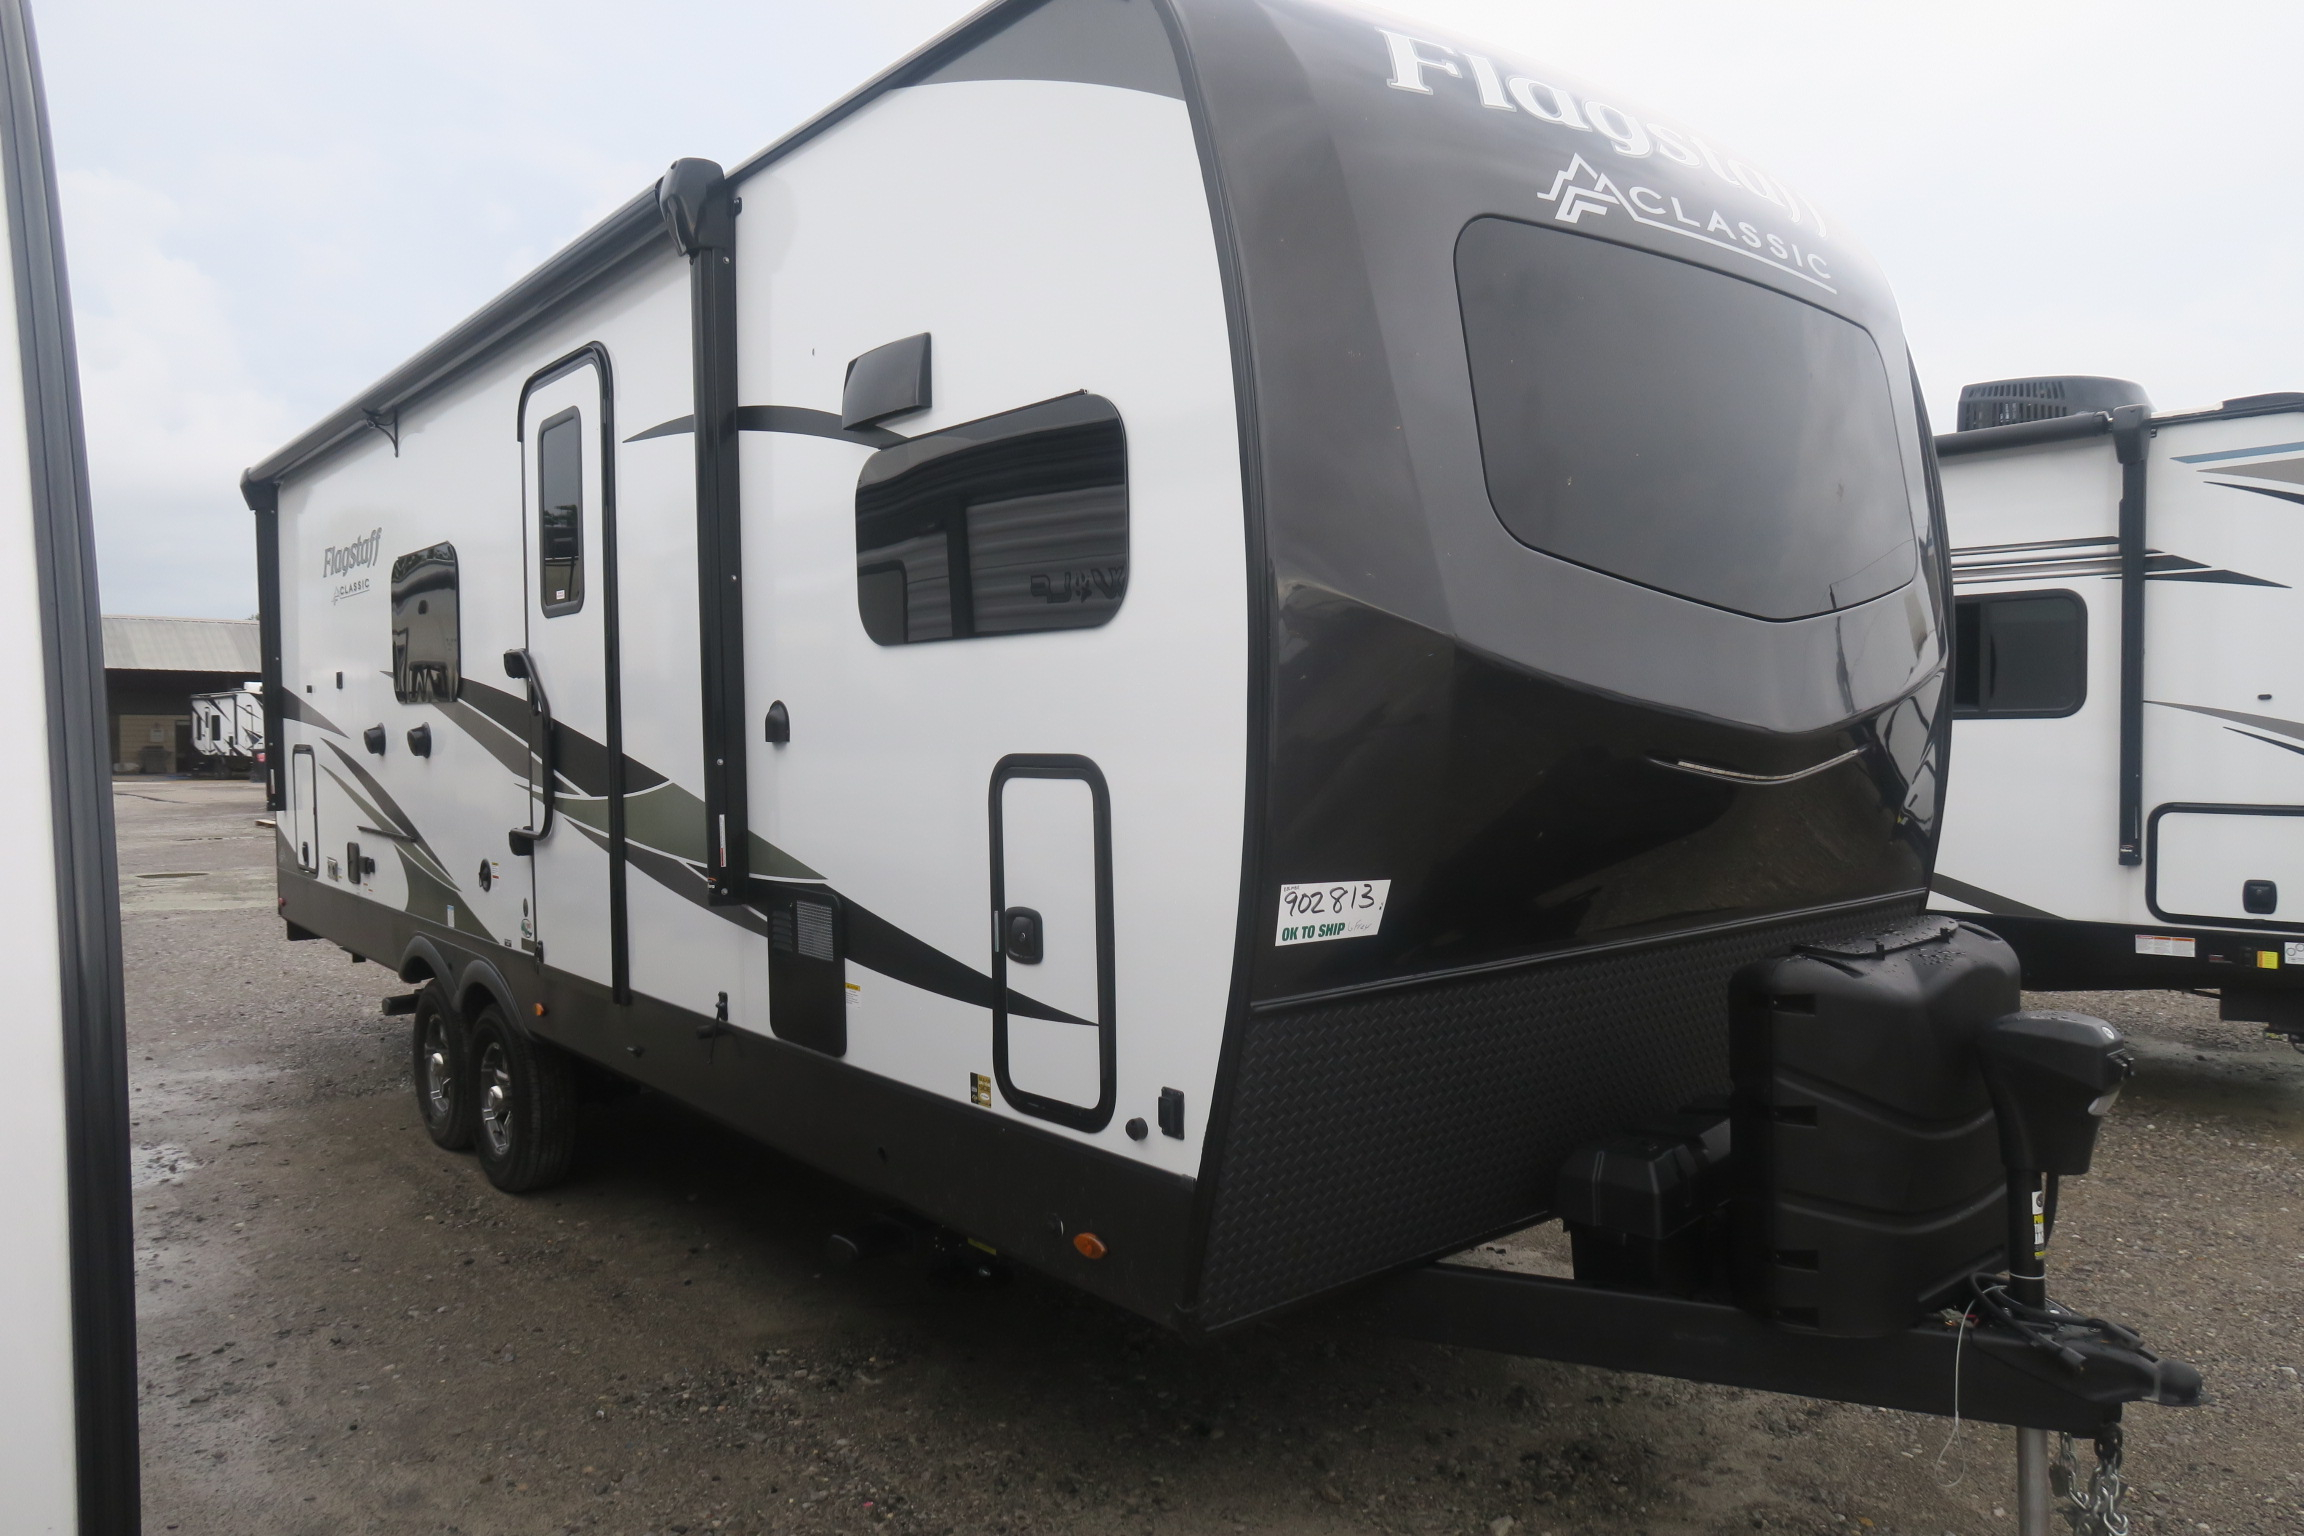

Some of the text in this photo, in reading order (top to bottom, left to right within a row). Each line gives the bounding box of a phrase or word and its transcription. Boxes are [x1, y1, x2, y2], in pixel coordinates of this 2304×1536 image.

[1628, 186, 1832, 279] CLASSIC
[323, 527, 382, 578] Flagstaff
[340, 579, 370, 595] CLASSIC
[1281, 922, 1346, 942] OK TO SHIP
